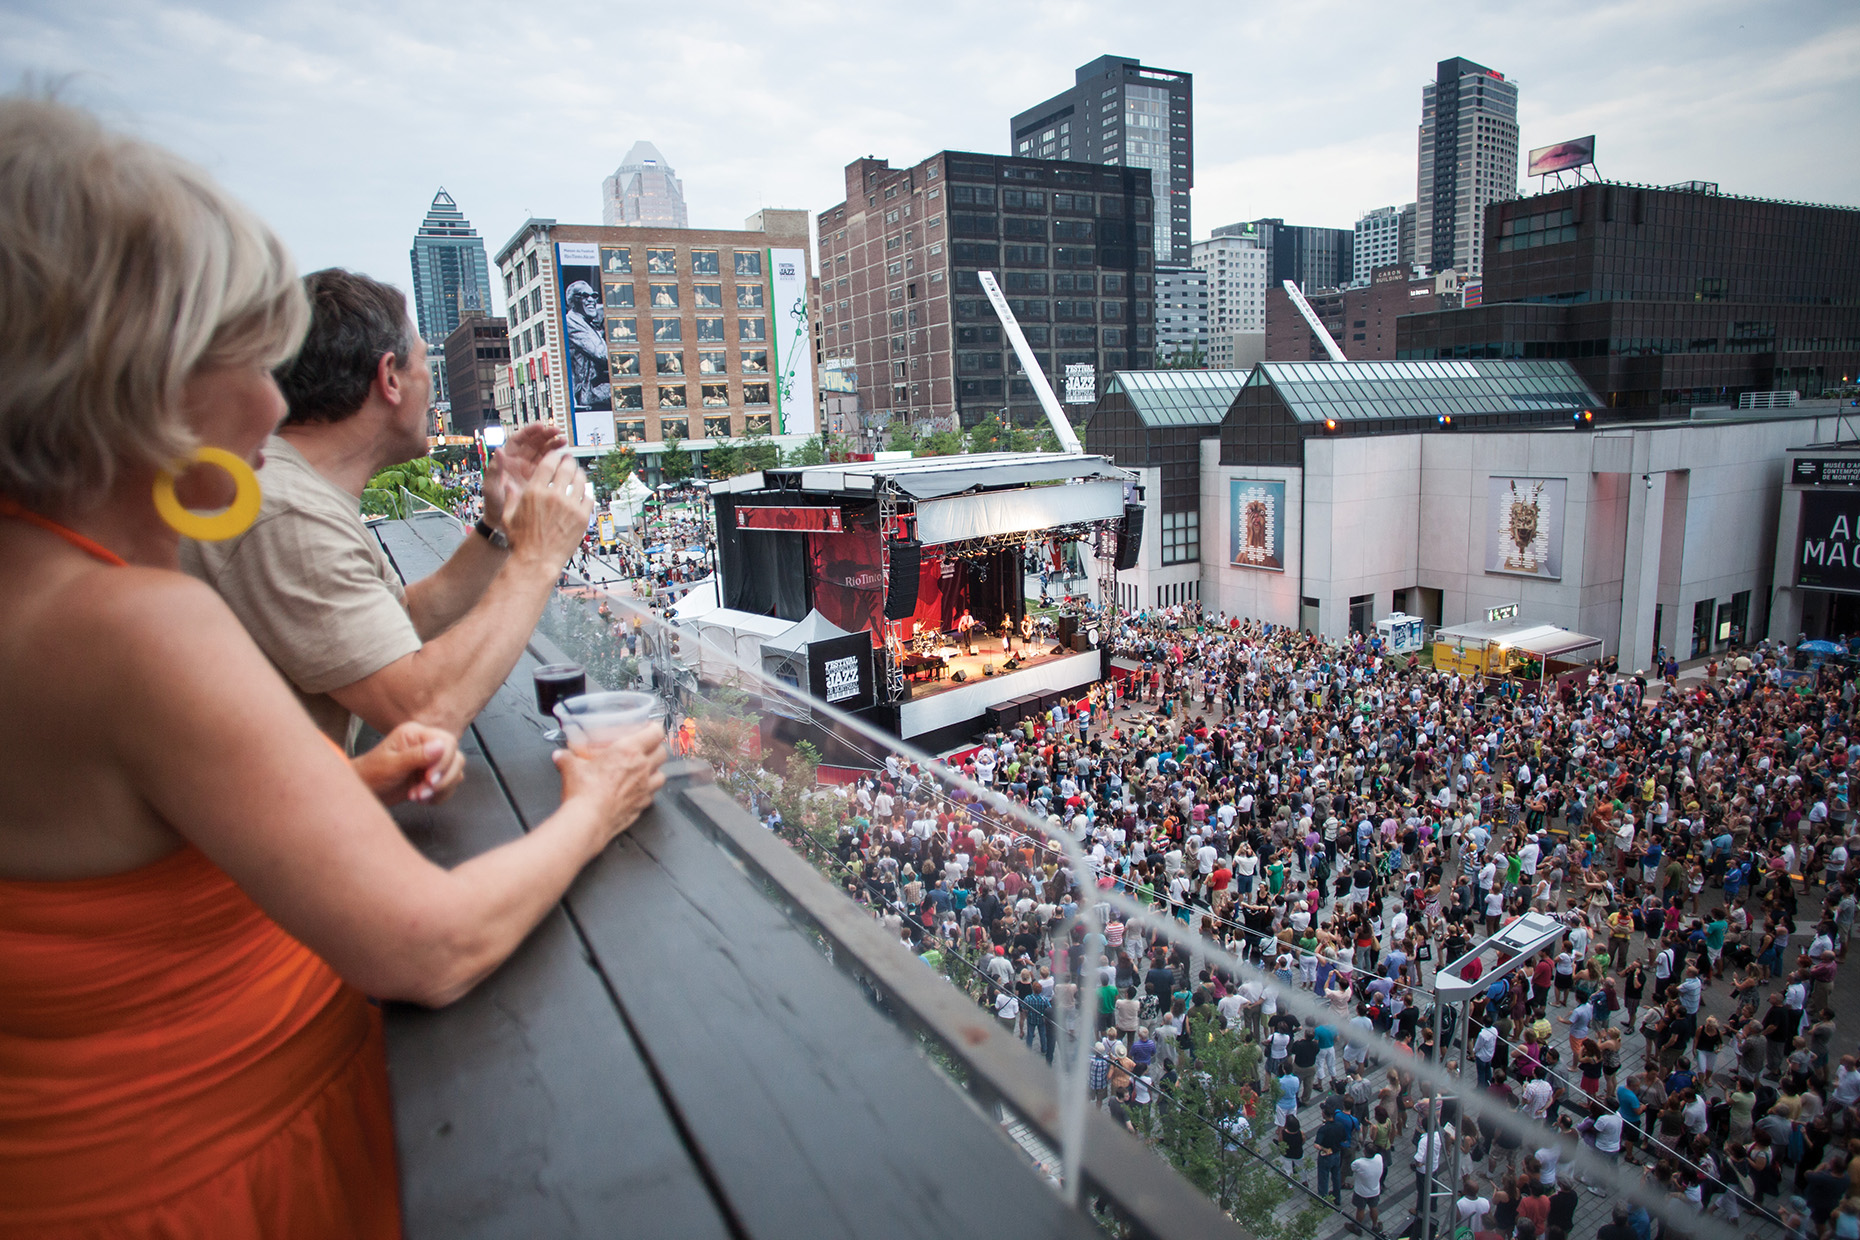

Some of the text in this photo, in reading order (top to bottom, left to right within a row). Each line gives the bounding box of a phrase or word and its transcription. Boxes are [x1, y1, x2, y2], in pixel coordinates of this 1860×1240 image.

[1376, 274, 1403, 283] BUILDING
[1065, 365, 1095, 373] FESTIVAL
[1065, 376, 1095, 390] JAZZ
[1832, 473, 1860, 481] MONTRÉ
[825, 656, 858, 670] FESTIVAL
[825, 668, 858, 688] JAZZ
